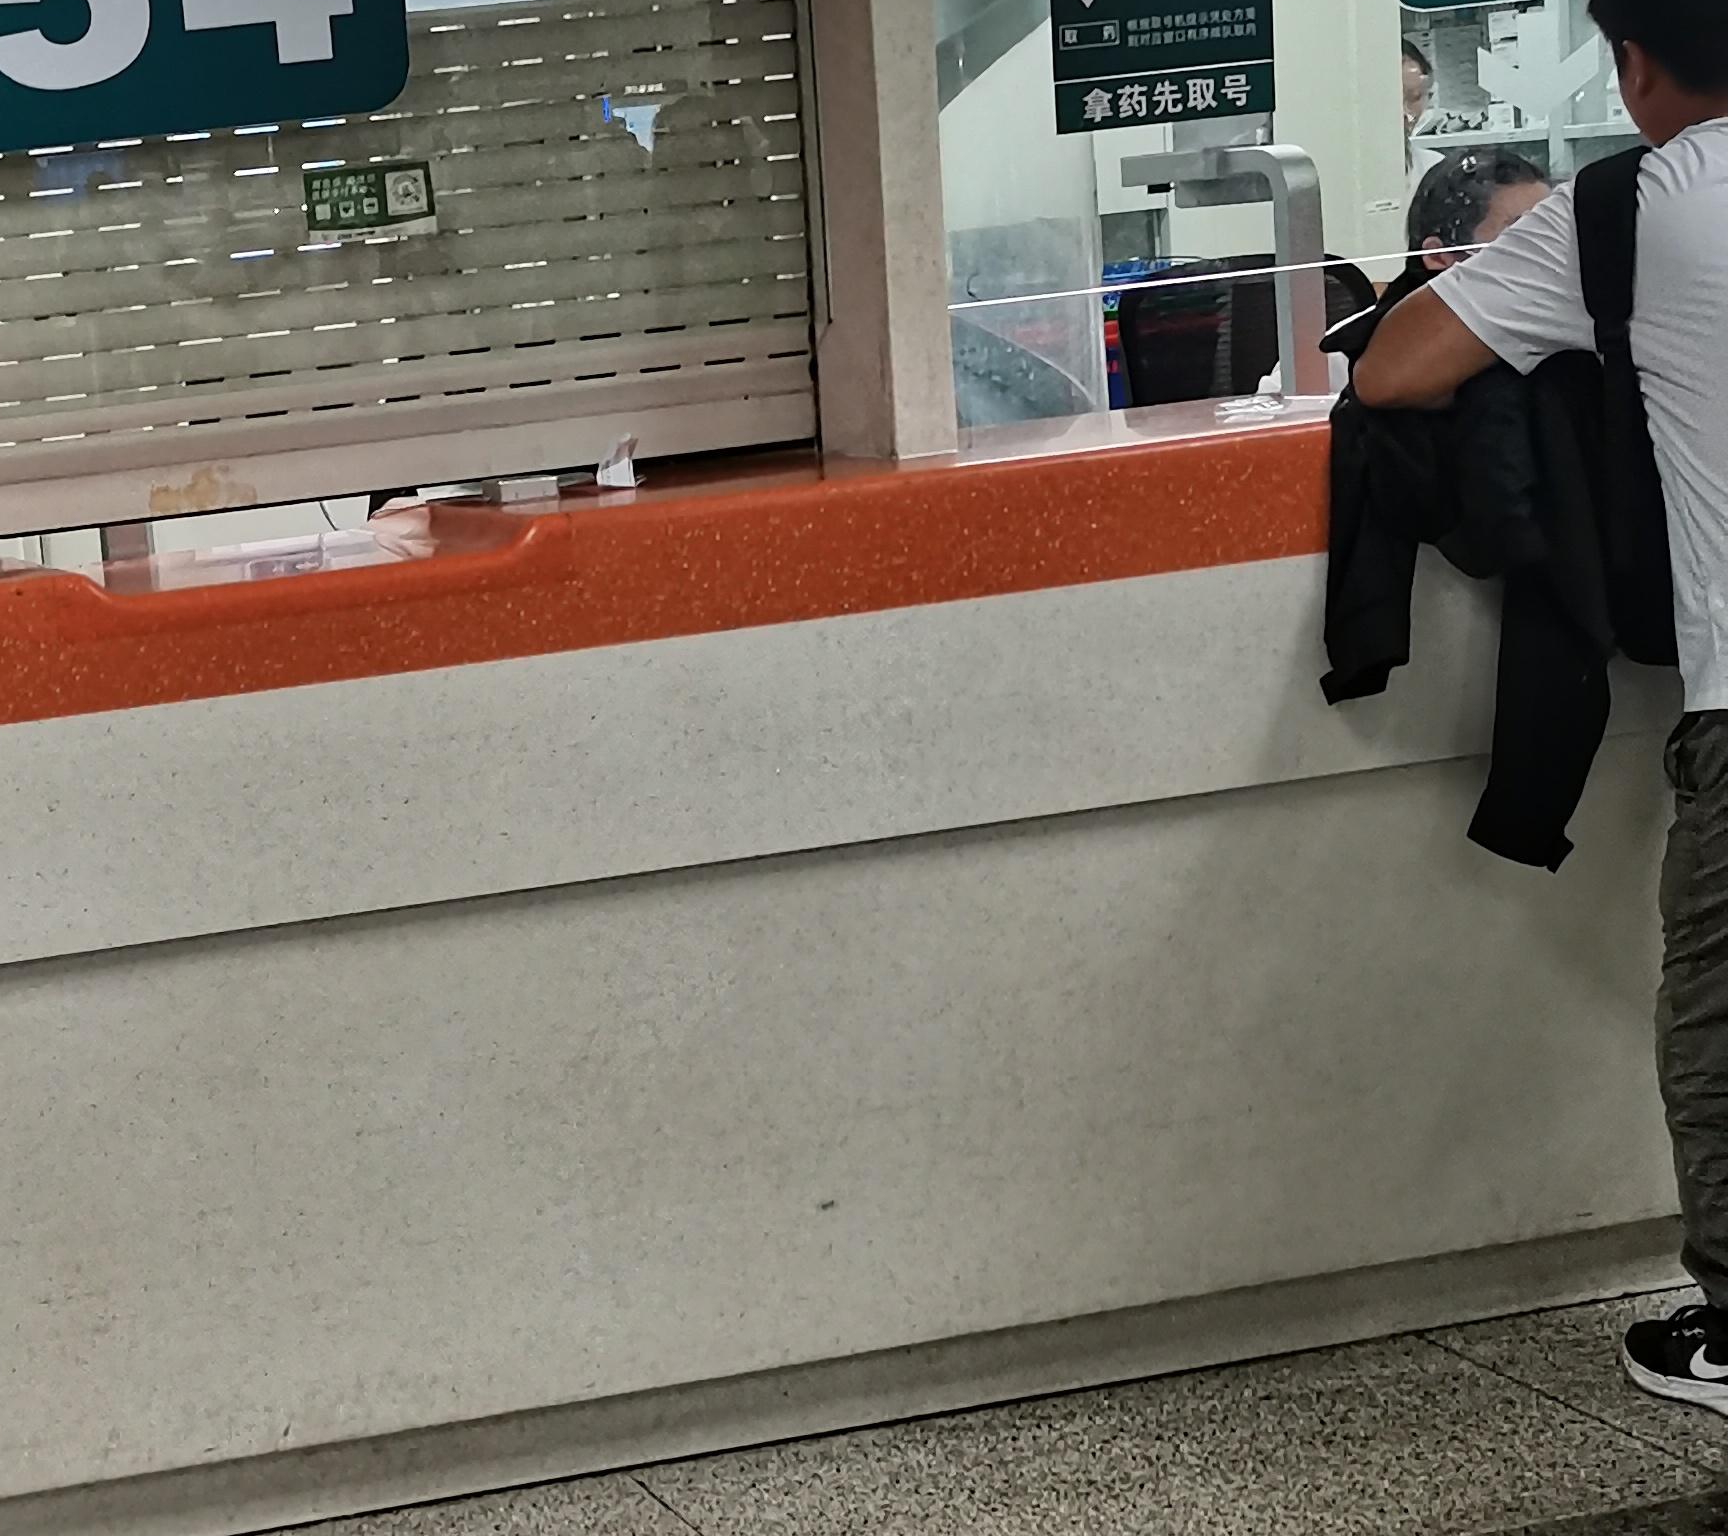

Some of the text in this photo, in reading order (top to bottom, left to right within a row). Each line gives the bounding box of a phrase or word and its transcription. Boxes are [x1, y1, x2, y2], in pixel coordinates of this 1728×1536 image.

[1082, 73, 1252, 124] 拿药先取号
